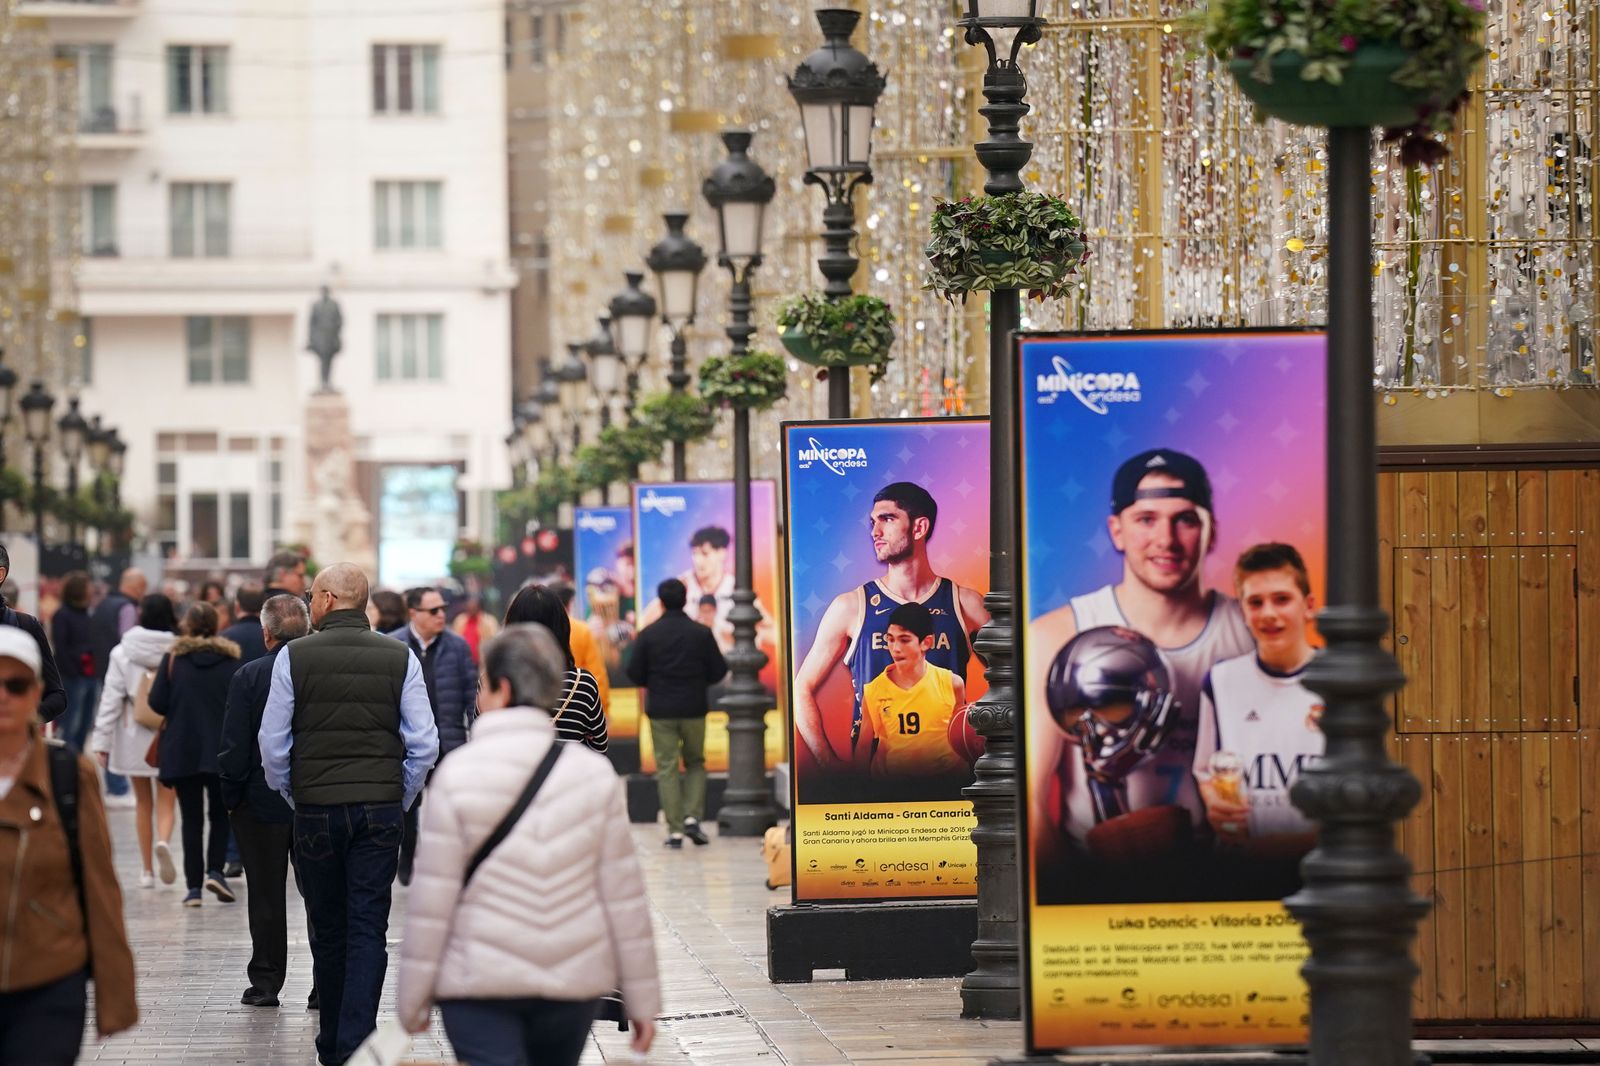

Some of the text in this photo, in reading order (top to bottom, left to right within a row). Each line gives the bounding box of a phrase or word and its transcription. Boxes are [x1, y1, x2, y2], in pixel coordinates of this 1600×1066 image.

[833, 460, 868, 468] endesa
[898, 711, 920, 735] 19
[825, 811, 851, 821] Santi
[853, 811, 894, 820] Aldama
[902, 810, 928, 819] Gran
[929, 808, 971, 818] Canaria
[852, 829, 867, 837] jugó
[877, 828, 909, 836] Minicopa
[856, 836, 878, 844] ahora
[918, 834, 950, 842] Memphis
[880, 861, 929, 872] endesa
[1108, 916, 1144, 930] Luka
[1210, 913, 1262, 928] Vitoria
[1157, 991, 1231, 1009] endesa
